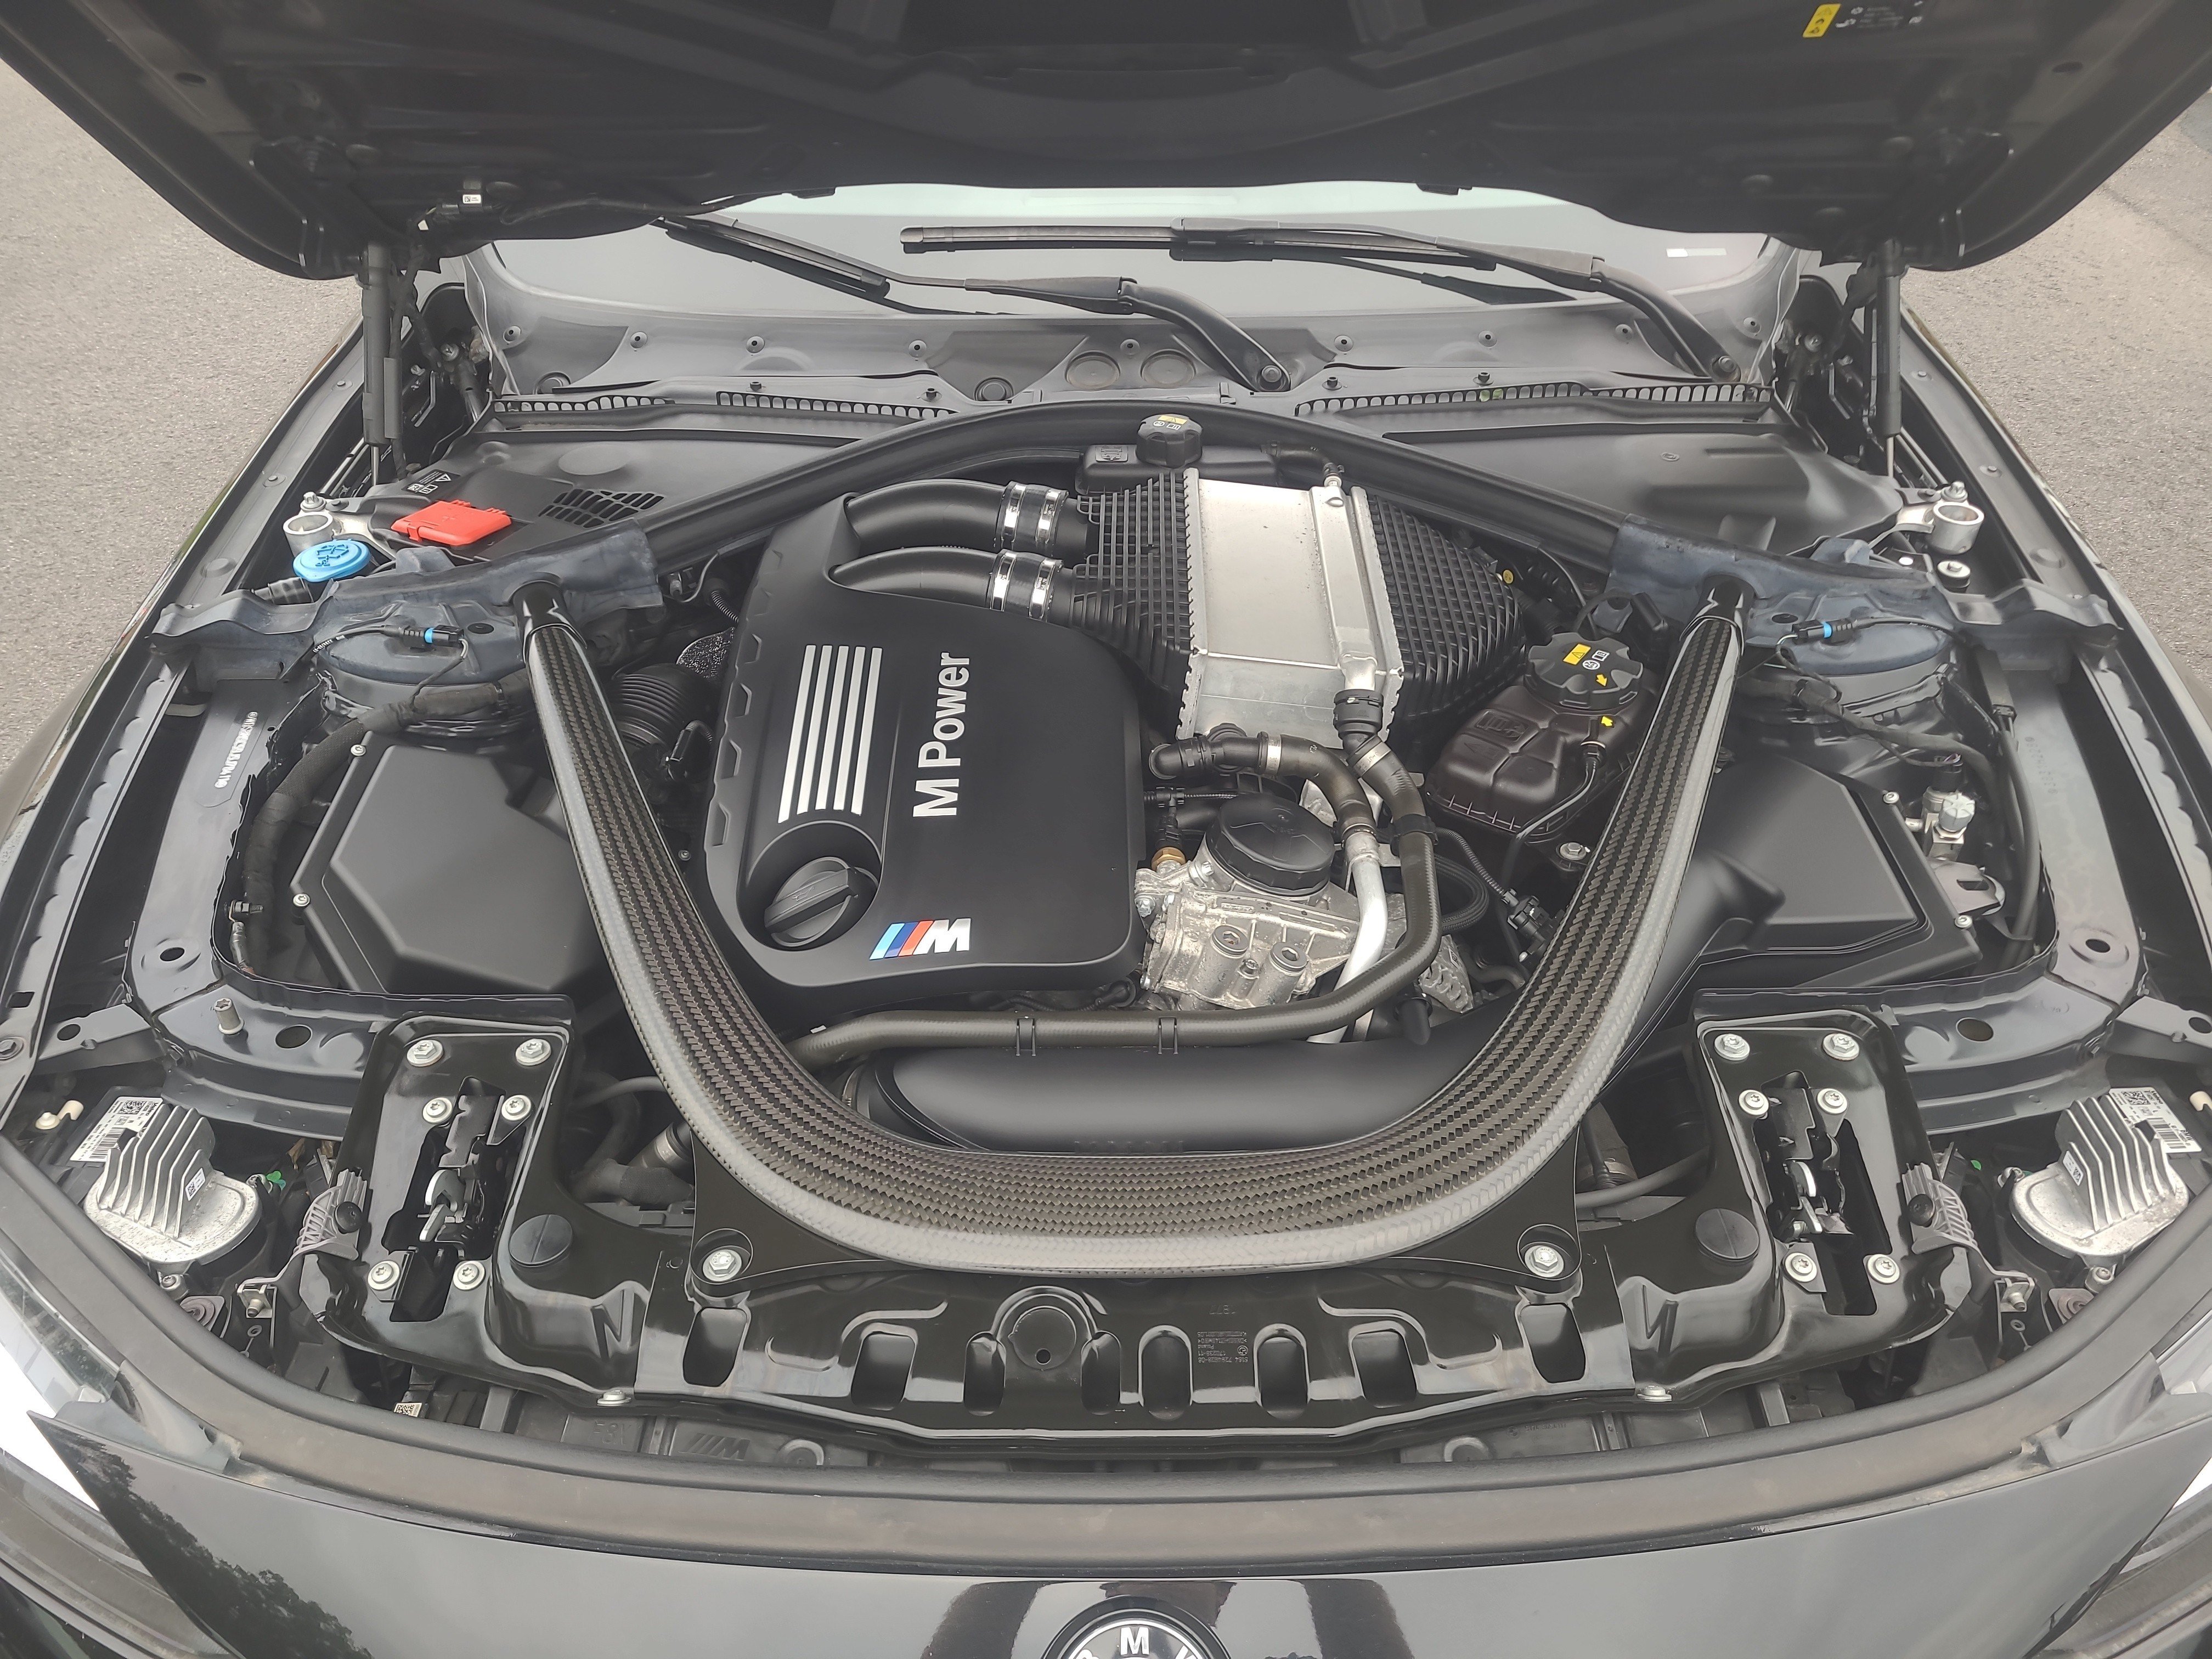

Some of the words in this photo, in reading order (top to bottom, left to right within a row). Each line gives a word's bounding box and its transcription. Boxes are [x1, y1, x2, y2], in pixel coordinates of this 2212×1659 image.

[918, 651, 970, 767] Power
[912, 778, 960, 818] M
[916, 917, 972, 954] M
[145, 1103, 159, 1116] Valeo
